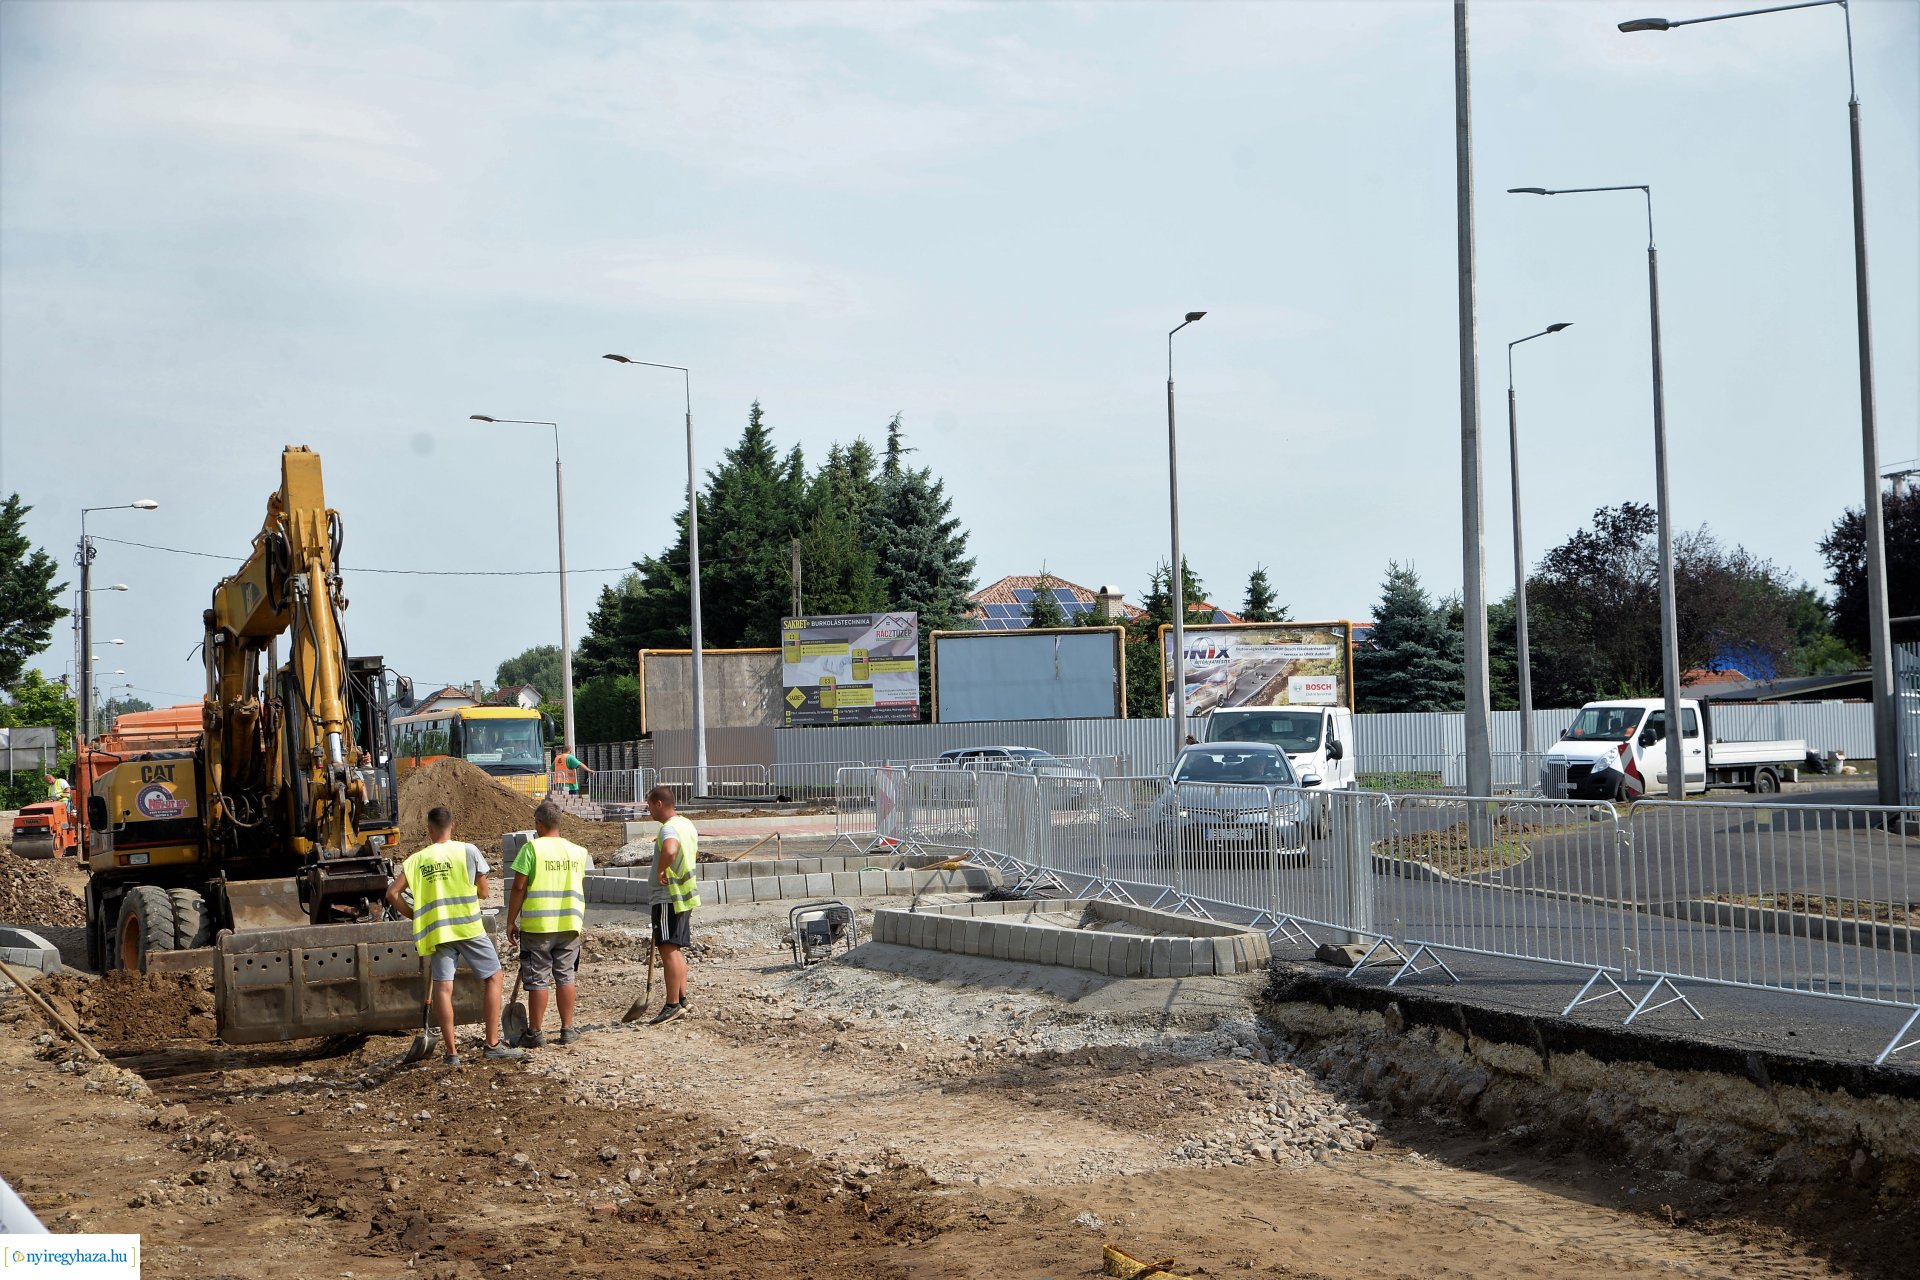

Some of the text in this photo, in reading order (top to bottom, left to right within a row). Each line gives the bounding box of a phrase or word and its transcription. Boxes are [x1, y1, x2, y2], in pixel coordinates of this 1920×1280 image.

[783, 618, 870, 629] SAKRET BURKOLÁSTECHNIKA
[141, 764, 175, 784] CAT
[545, 858, 570, 871] TISZA-ÚT
